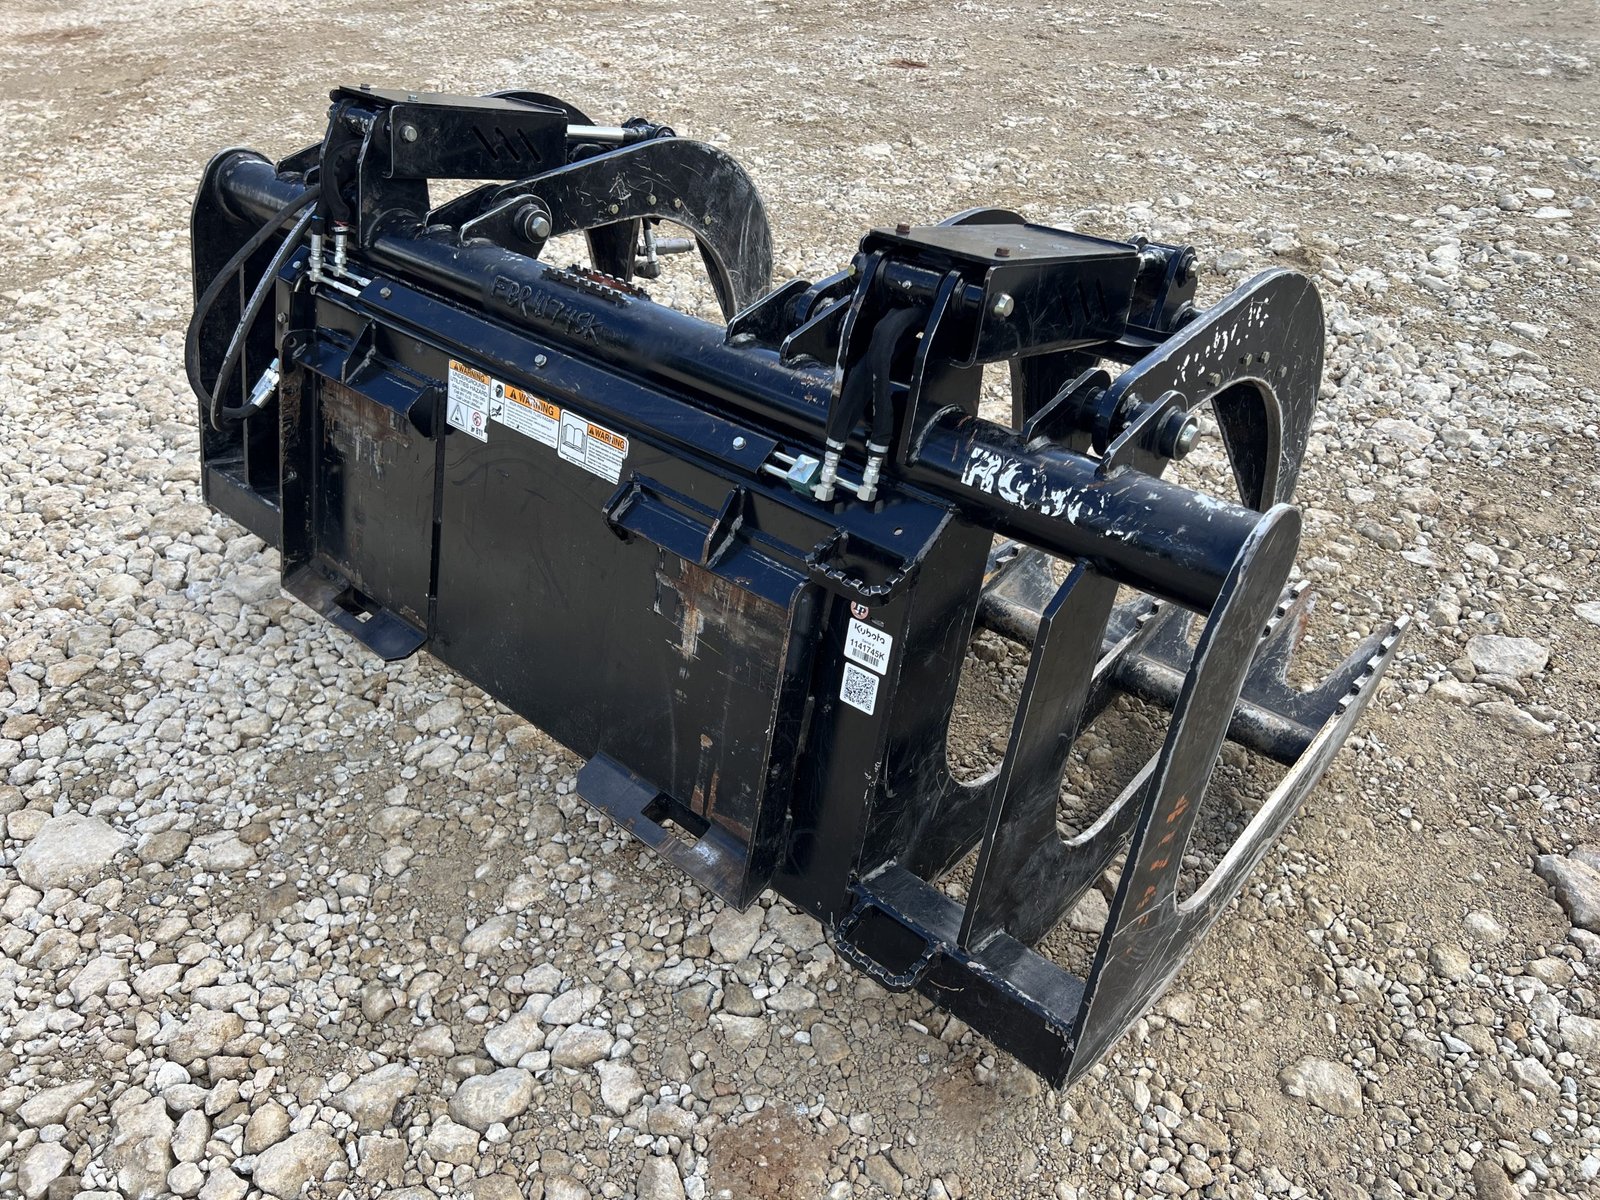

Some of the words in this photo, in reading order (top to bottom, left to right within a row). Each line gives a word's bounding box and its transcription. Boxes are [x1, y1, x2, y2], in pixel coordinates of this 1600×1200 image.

[452, 371, 486, 390] UNDERGROUND
[458, 364, 485, 383] WARNING
[470, 386, 488, 397] HAZARD
[595, 429, 625, 449] WARNING
[854, 623, 885, 645] Kubota
[851, 639, 885, 661] 1141745K
